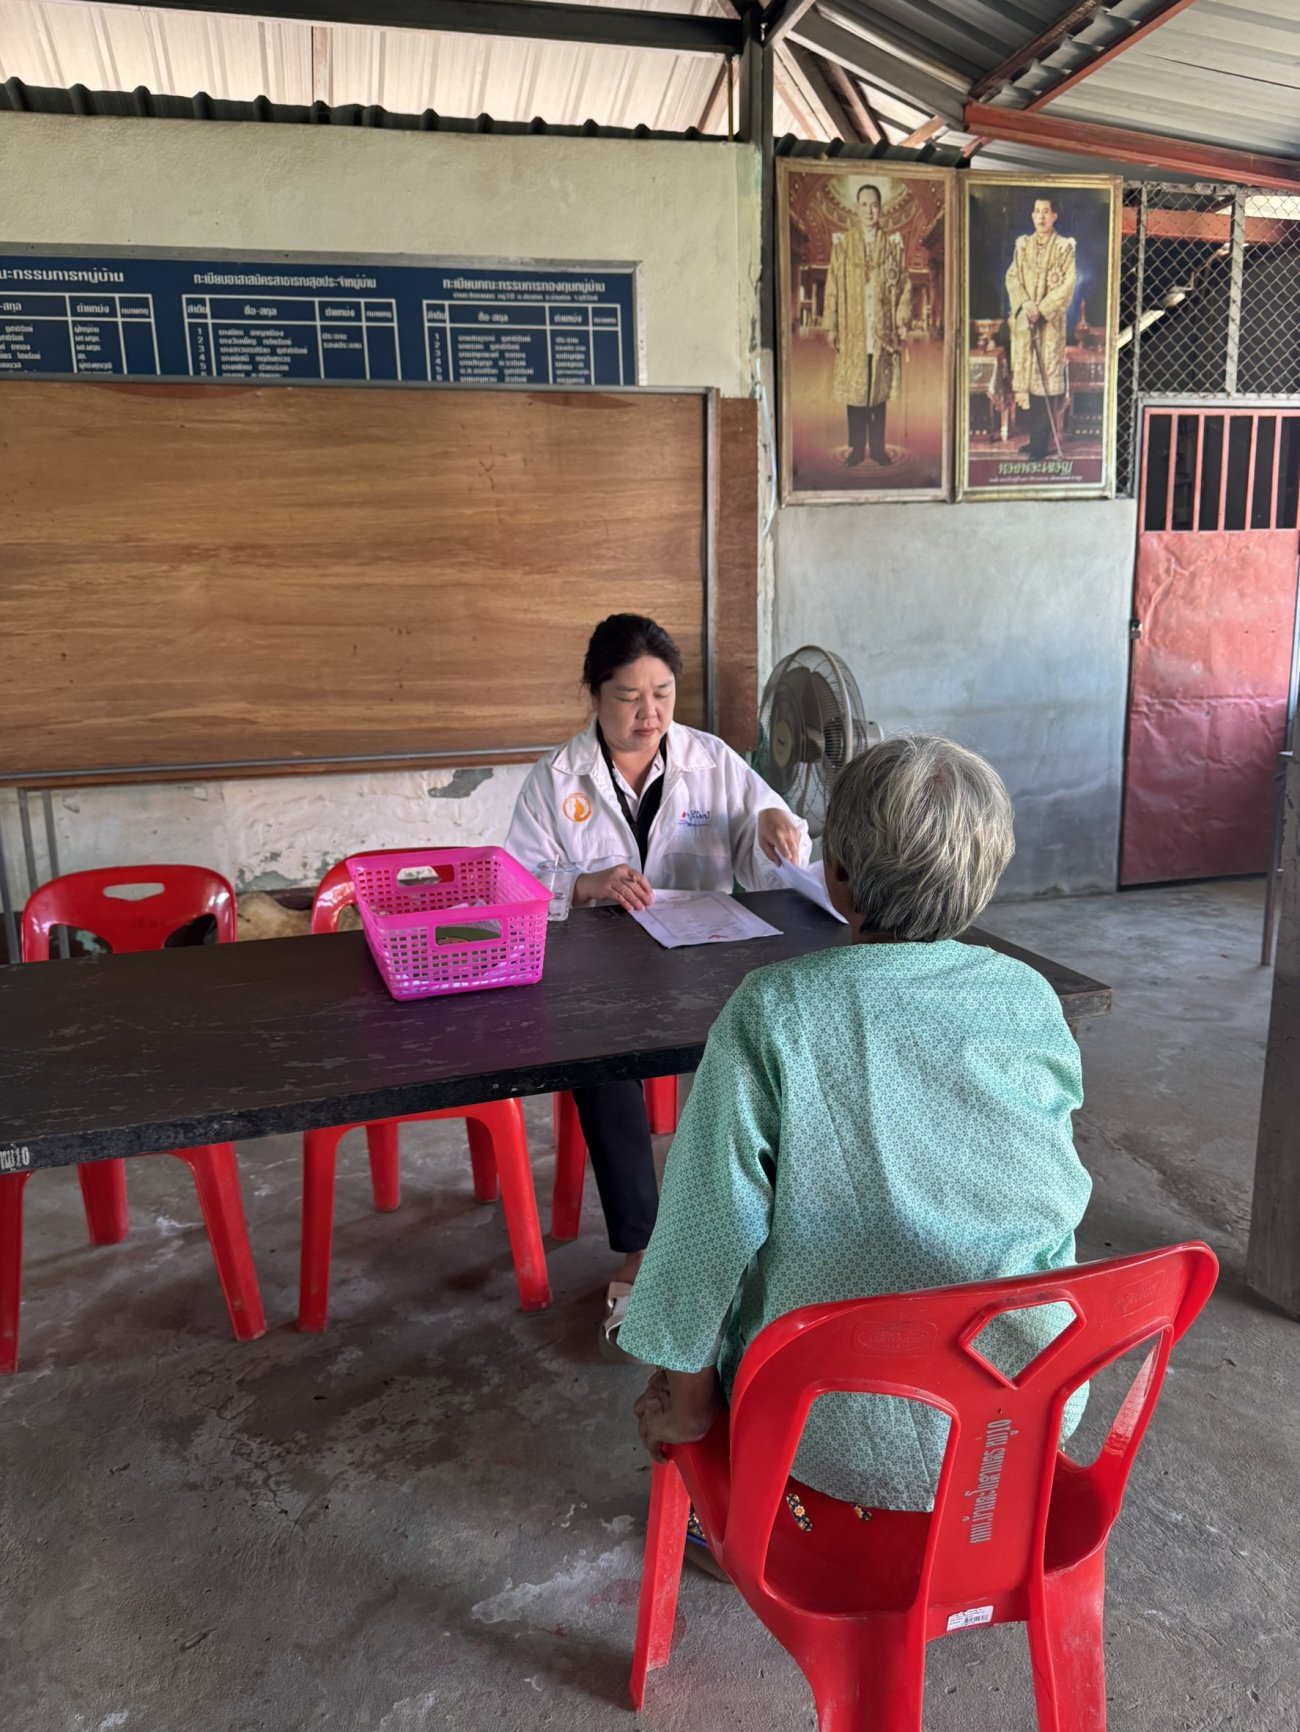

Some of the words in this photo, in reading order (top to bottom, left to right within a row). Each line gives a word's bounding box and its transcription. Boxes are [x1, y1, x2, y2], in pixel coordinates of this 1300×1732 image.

[77, 303, 110, 313] ตำแหน่ง
[121, 307, 149, 316] หมายเหตุ
[324, 306, 356, 318] ตำแหน่ง
[554, 312, 582, 324] ตำแหน่ง
[198, 345, 205, 353] 3
[434, 341, 441, 349] 2
[198, 354, 206, 362] 4
[434, 358, 442, 366] 4
[435, 366, 443, 374] 5
[997, 459, 1074, 476] ทรงพระเจริญ
